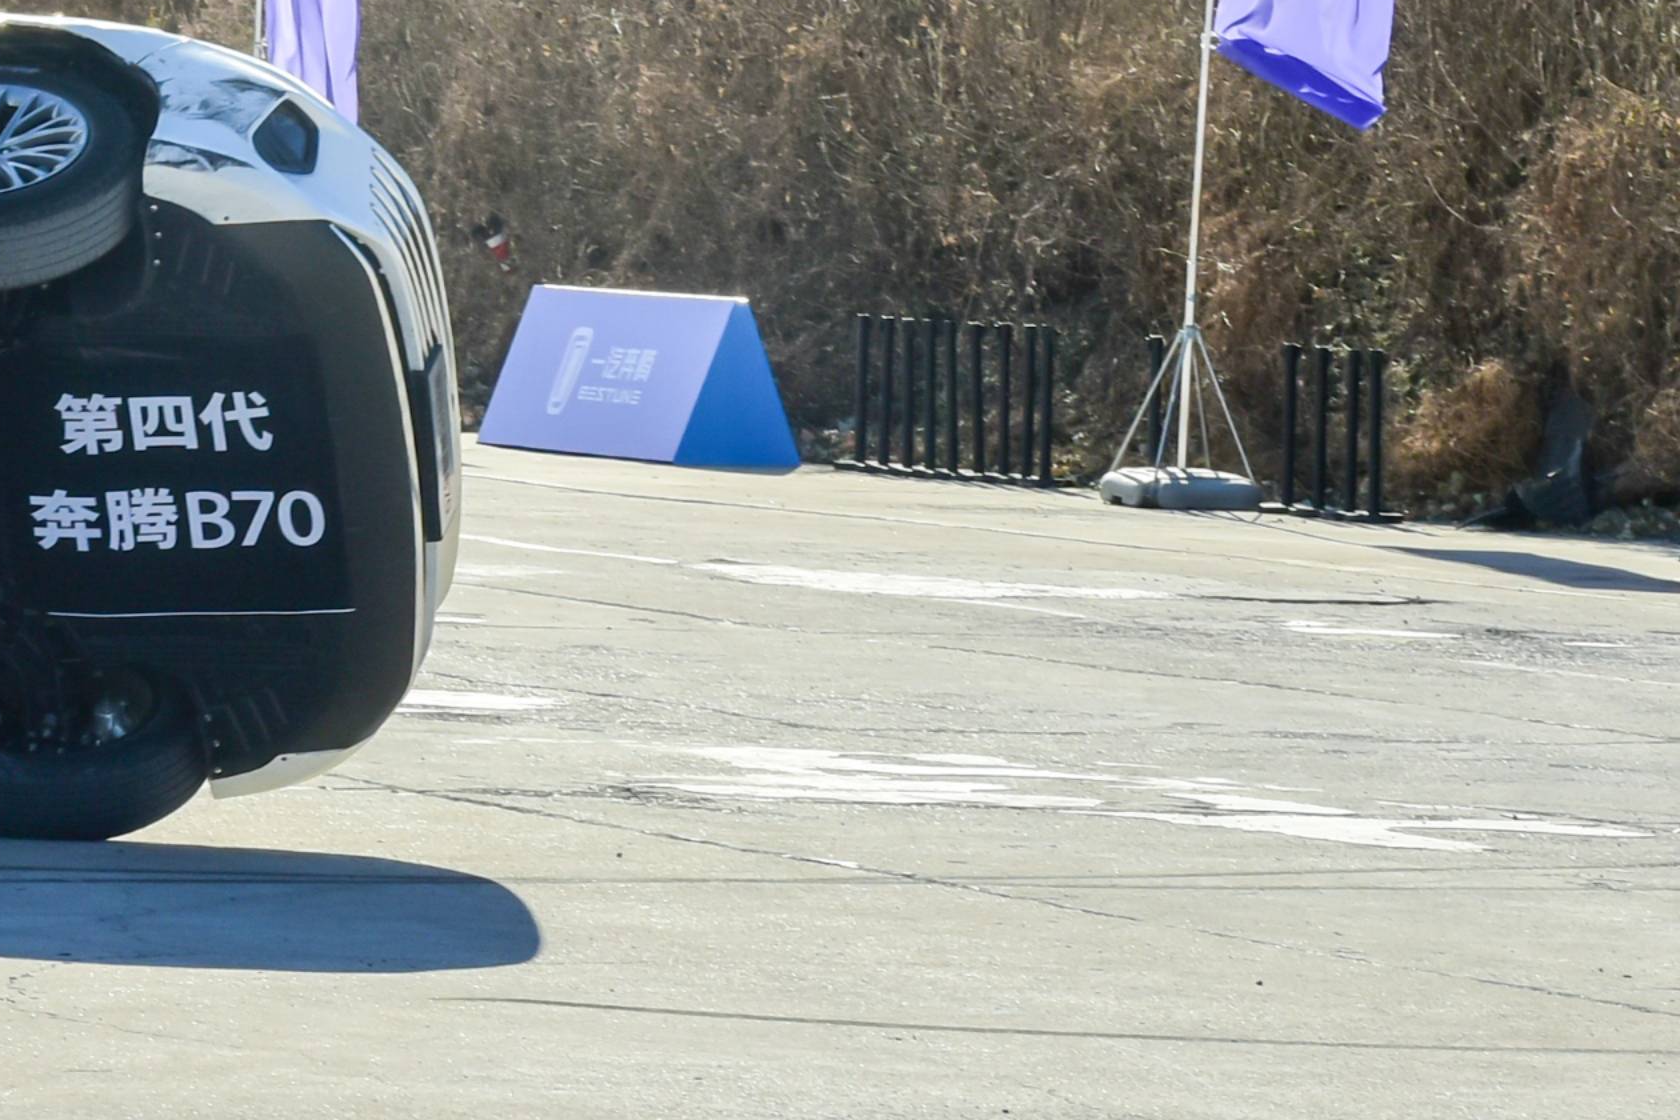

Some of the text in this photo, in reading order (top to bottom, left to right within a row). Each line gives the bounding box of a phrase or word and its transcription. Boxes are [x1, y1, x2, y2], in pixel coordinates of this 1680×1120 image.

[54, 391, 274, 456] 第四代
[28, 486, 326, 553] 奔腾B70
